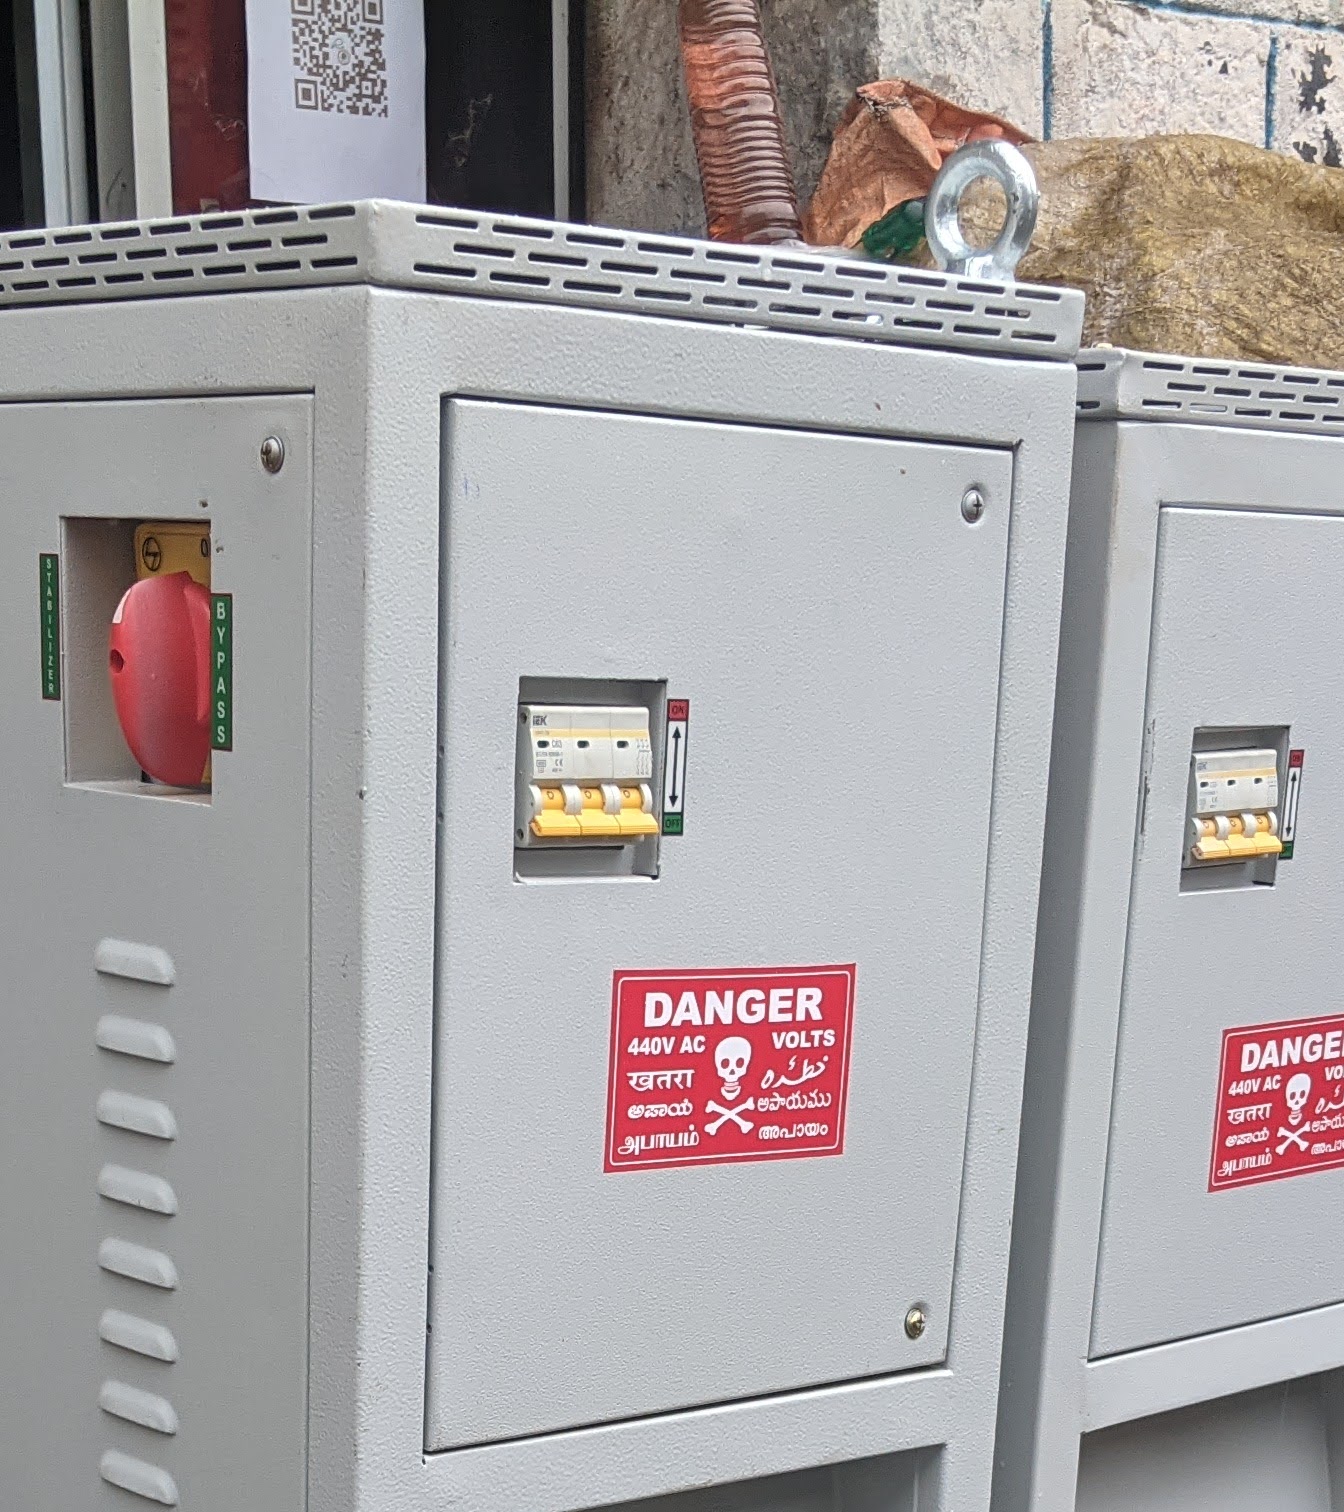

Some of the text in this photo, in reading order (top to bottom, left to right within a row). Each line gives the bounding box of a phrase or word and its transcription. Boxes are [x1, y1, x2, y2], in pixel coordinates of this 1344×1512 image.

[46, 558, 55, 694] STABILIZER
[216, 602, 226, 744] BYPASS
[665, 818, 680, 828] OFF
[644, 987, 823, 1028] DANGER
[627, 1029, 836, 1056] 440V AC VOLTS
[627, 1069, 695, 1092] खतरा
[1228, 1077, 1261, 1096] 440V
[1262, 1074, 1282, 1091] AC
[1227, 1103, 1273, 1124] खतरा
[617, 1124, 700, 1156] அபாயம்
[758, 1122, 829, 1140] അപായം
